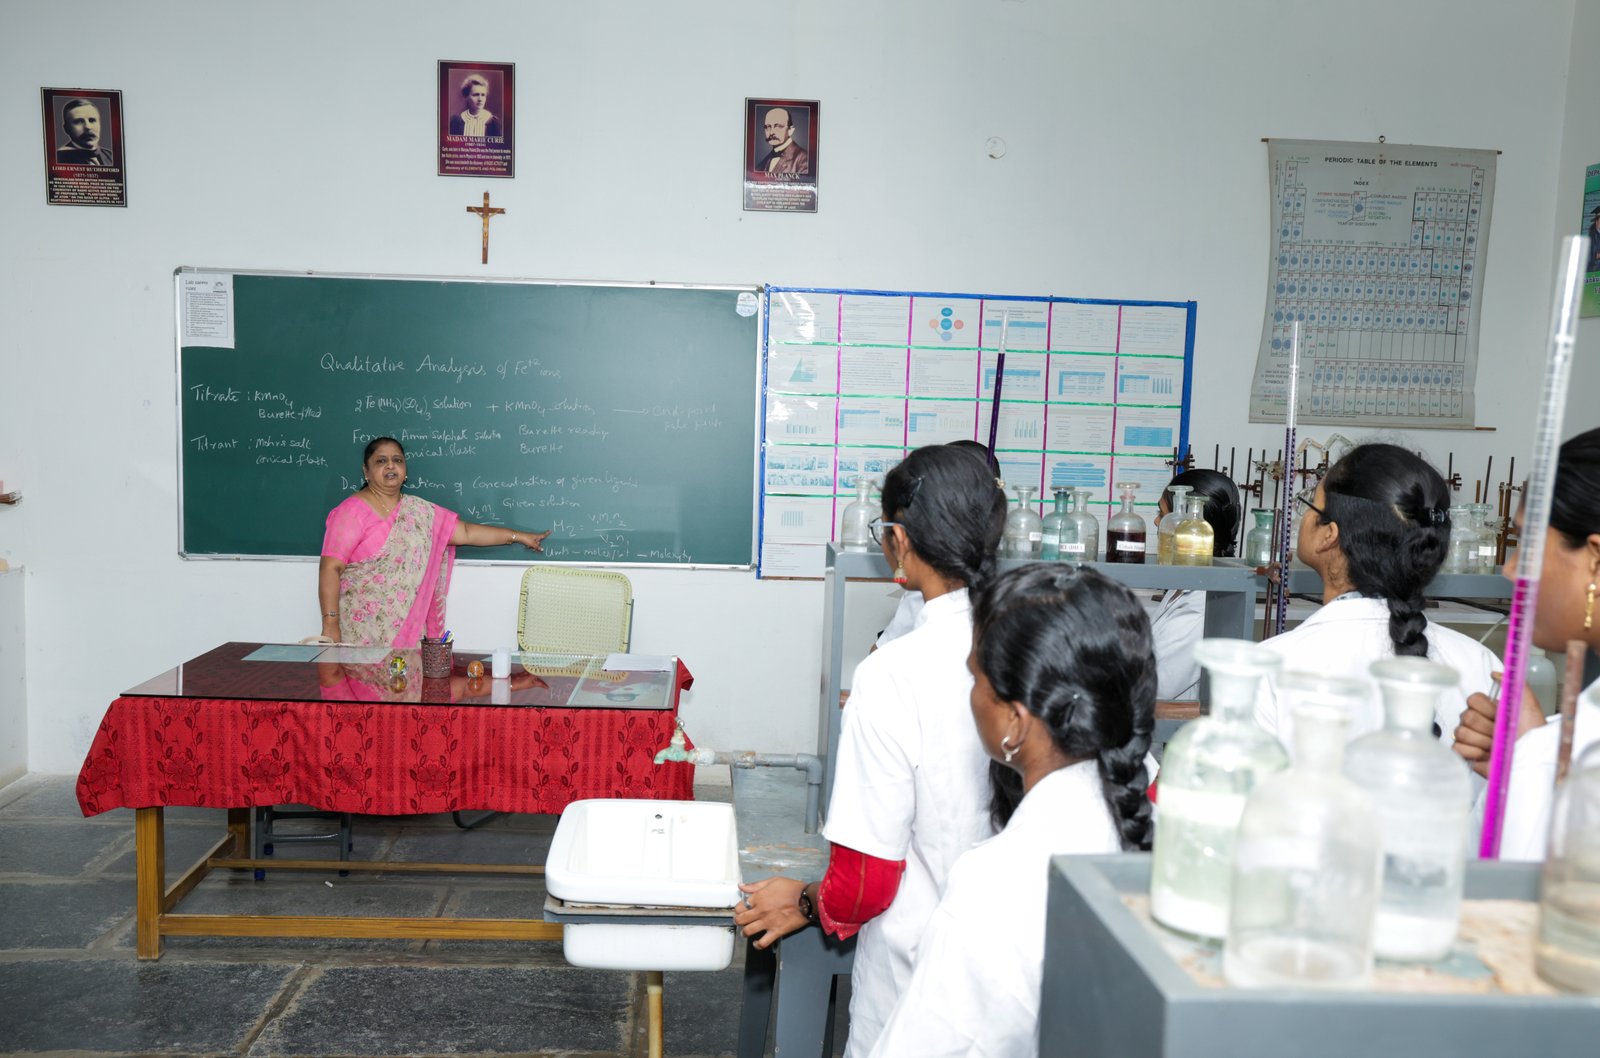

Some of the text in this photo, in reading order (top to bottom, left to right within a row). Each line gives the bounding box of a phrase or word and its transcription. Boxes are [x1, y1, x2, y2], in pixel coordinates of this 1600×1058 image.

[320, 352, 406, 373] Qualitative
[415, 354, 486, 383] Analysis
[496, 360, 508, 380] of
[190, 384, 242, 402] Titrate
[518, 424, 563, 437] Burette
[190, 434, 238, 452] Titrant
[405, 444, 444, 460] onical
[520, 442, 564, 455] Burette
[502, 496, 536, 508] Given
